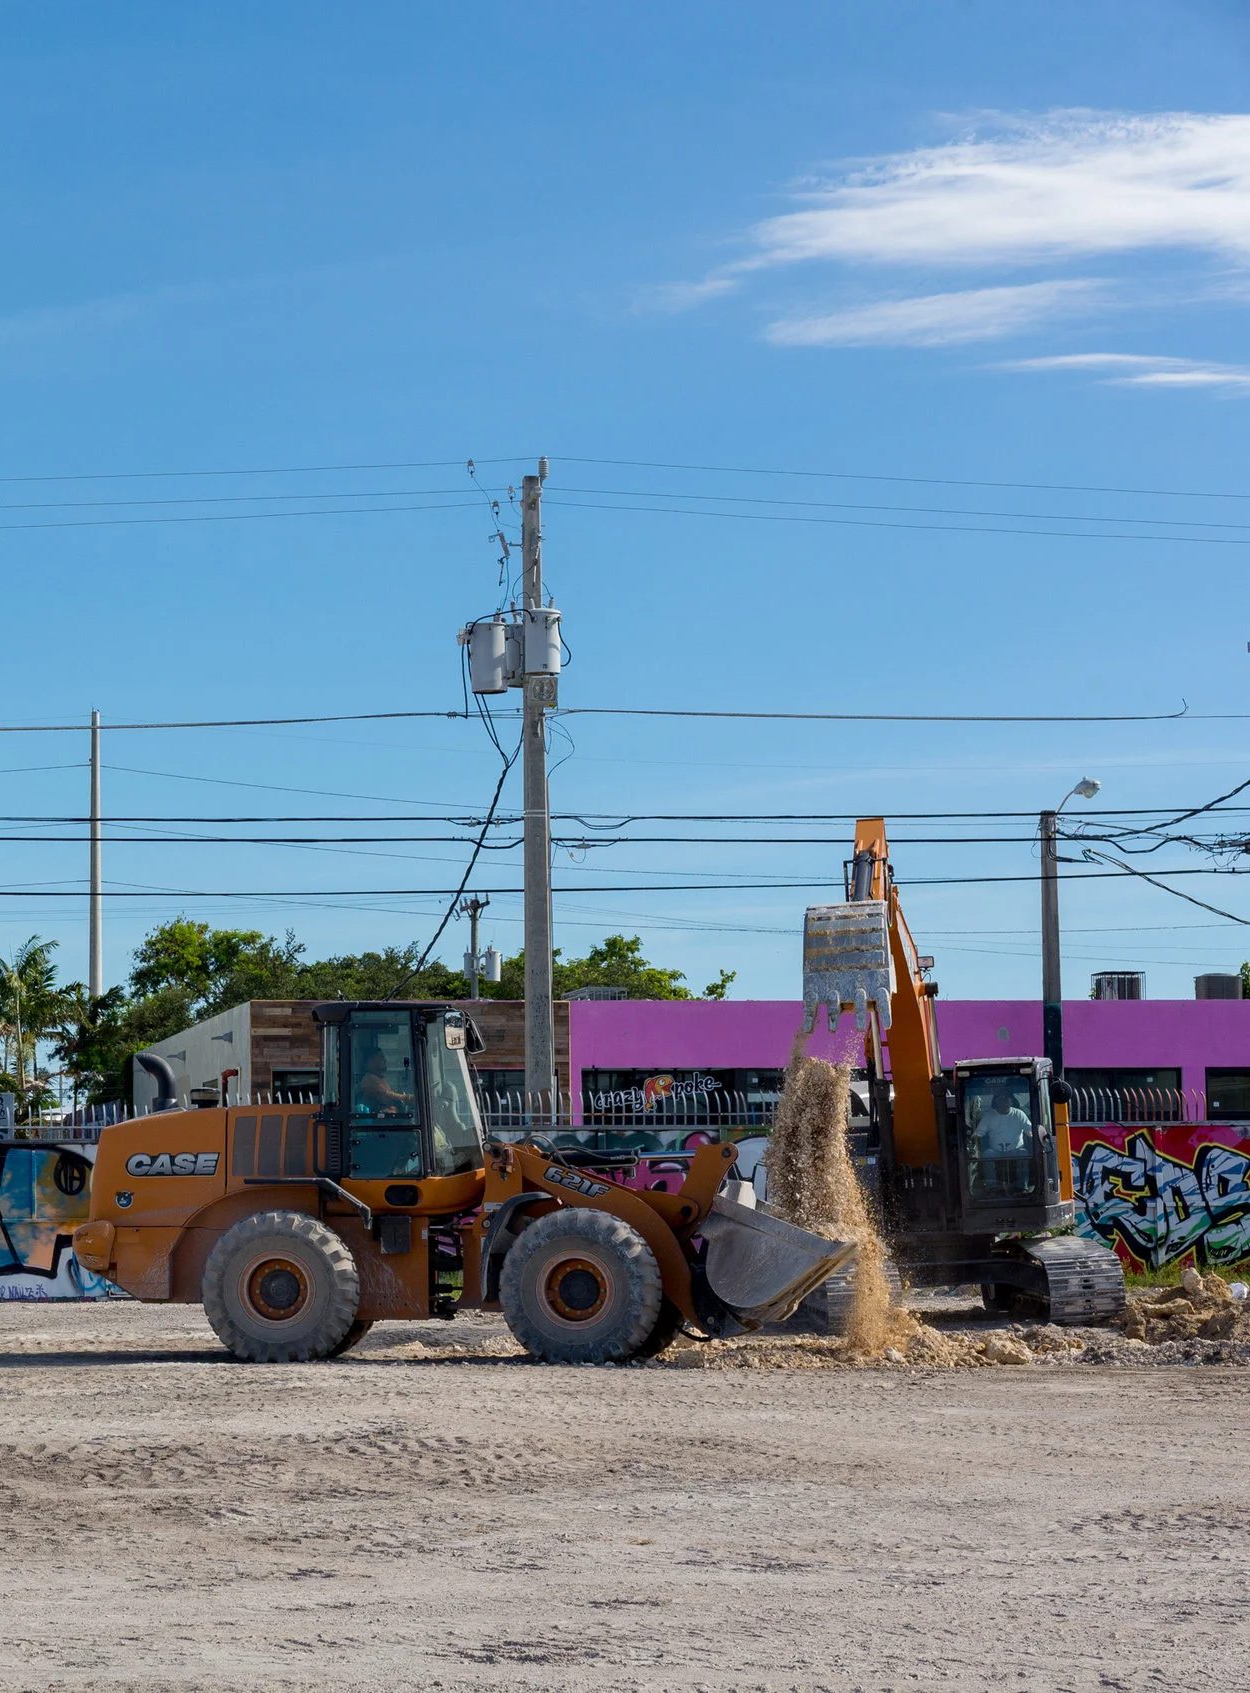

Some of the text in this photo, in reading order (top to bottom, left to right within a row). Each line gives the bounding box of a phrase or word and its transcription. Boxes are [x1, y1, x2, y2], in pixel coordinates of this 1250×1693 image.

[595, 1072, 722, 1112] crazy poke
[126, 1152, 219, 1177] CASE
[544, 1166, 611, 1198] 621F
